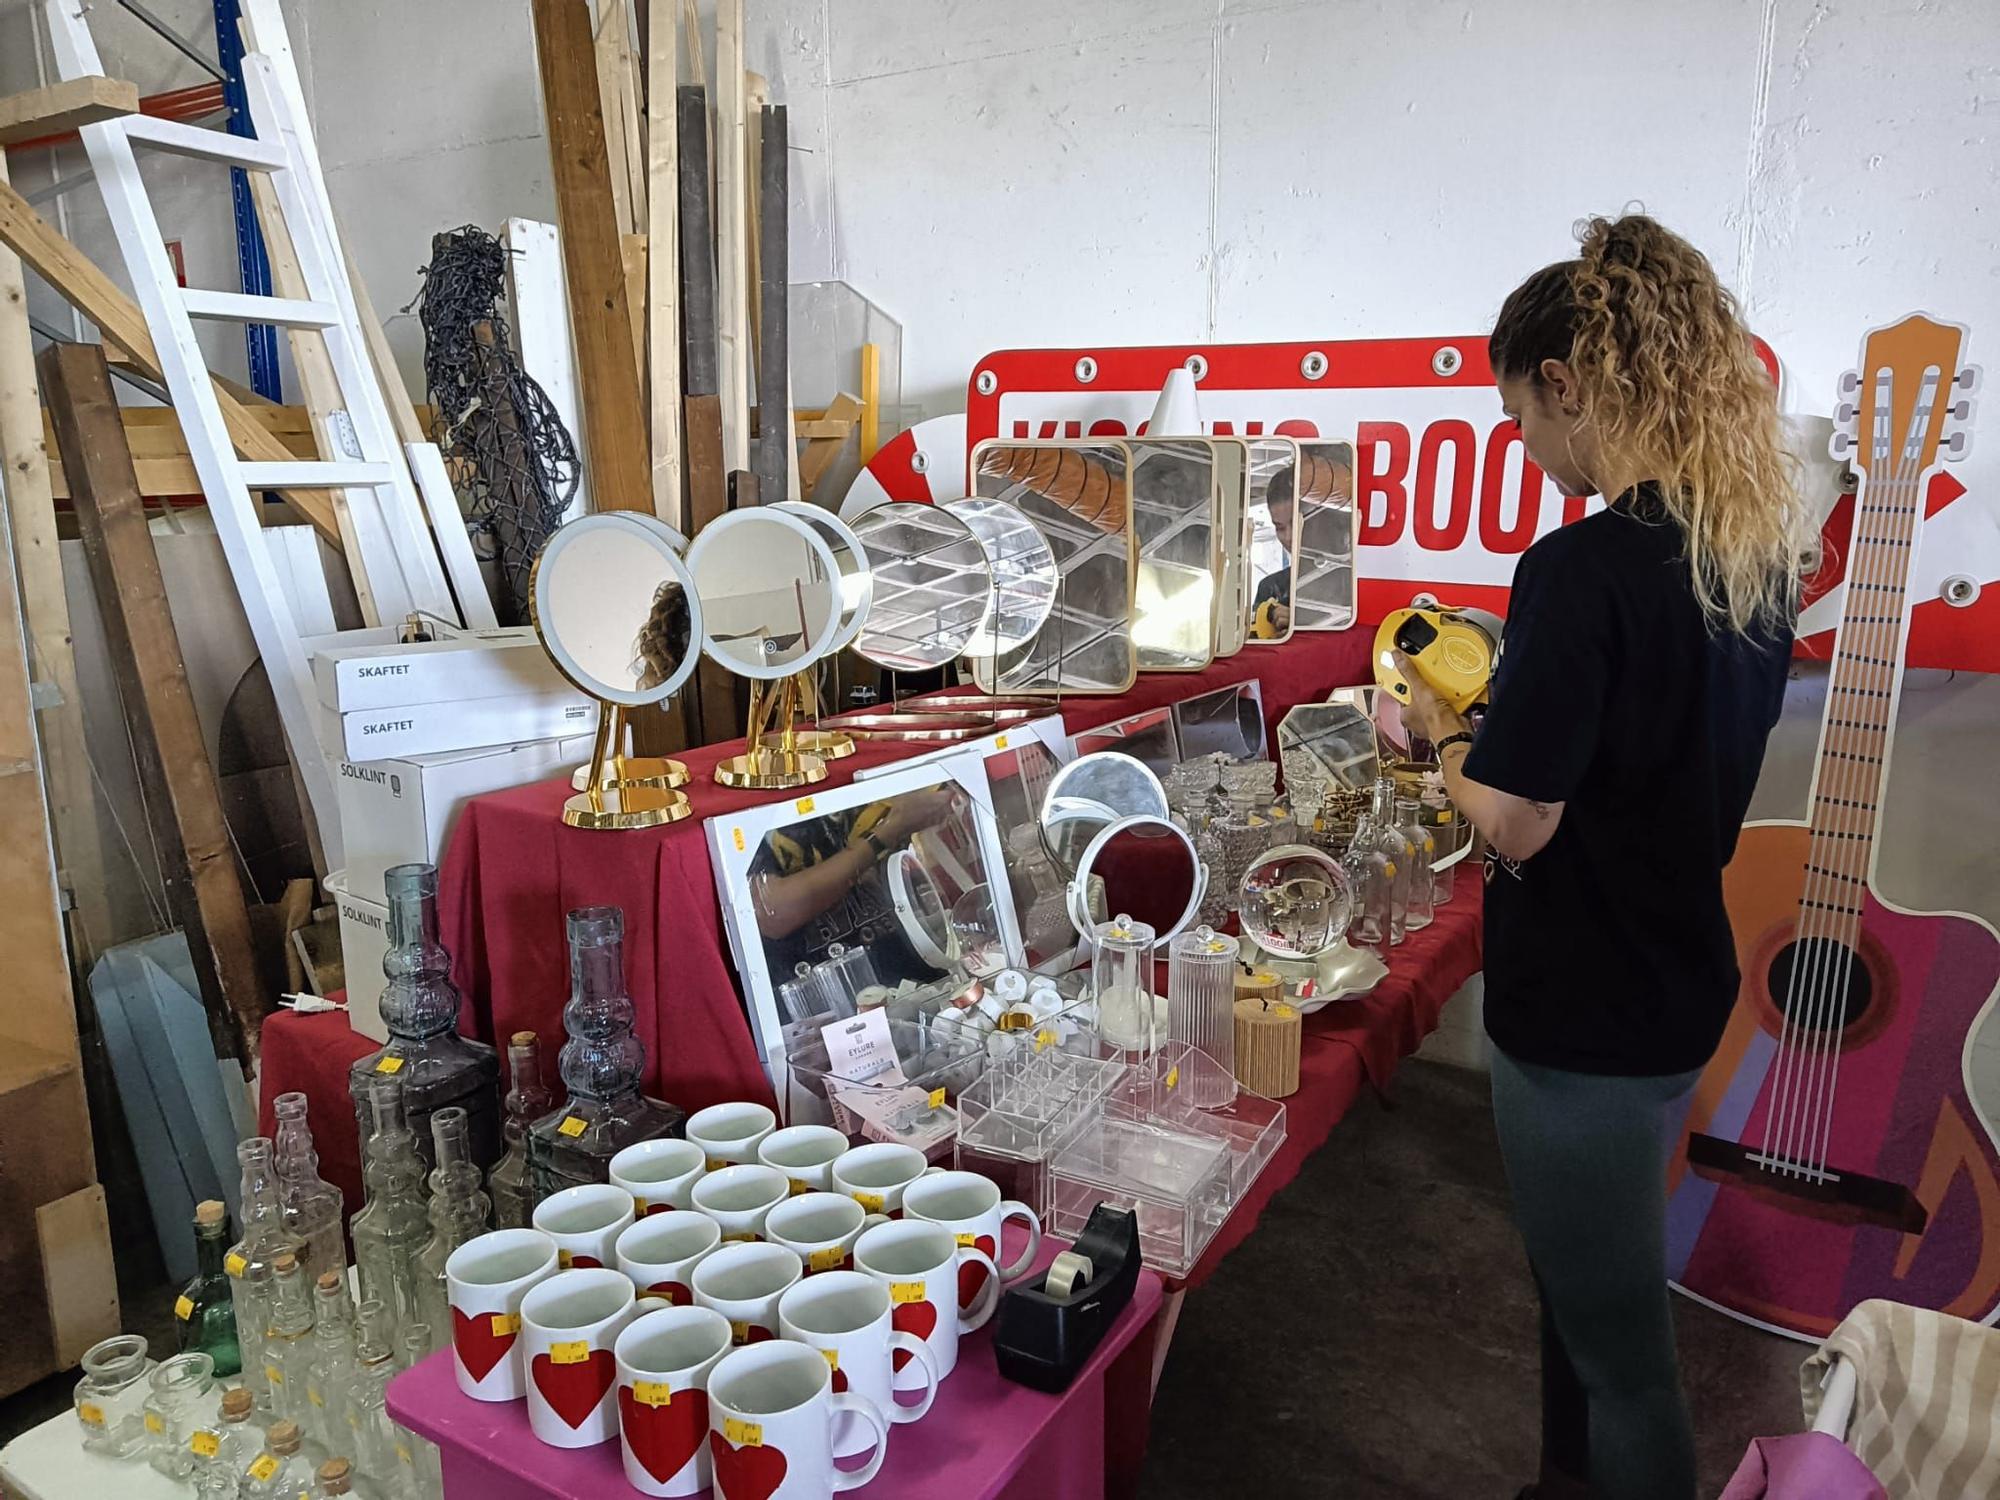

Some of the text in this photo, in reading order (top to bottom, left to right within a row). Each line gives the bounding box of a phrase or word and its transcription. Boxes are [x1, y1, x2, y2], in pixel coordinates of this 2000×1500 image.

[1357, 419, 1587, 553] BOO
[358, 664, 410, 678] SKAFTET
[363, 720, 413, 735] SKAFTET
[340, 763, 386, 785] SOLKLINT
[342, 904, 382, 930] SOLKLINT
[848, 1041, 875, 1057] EYLURE
